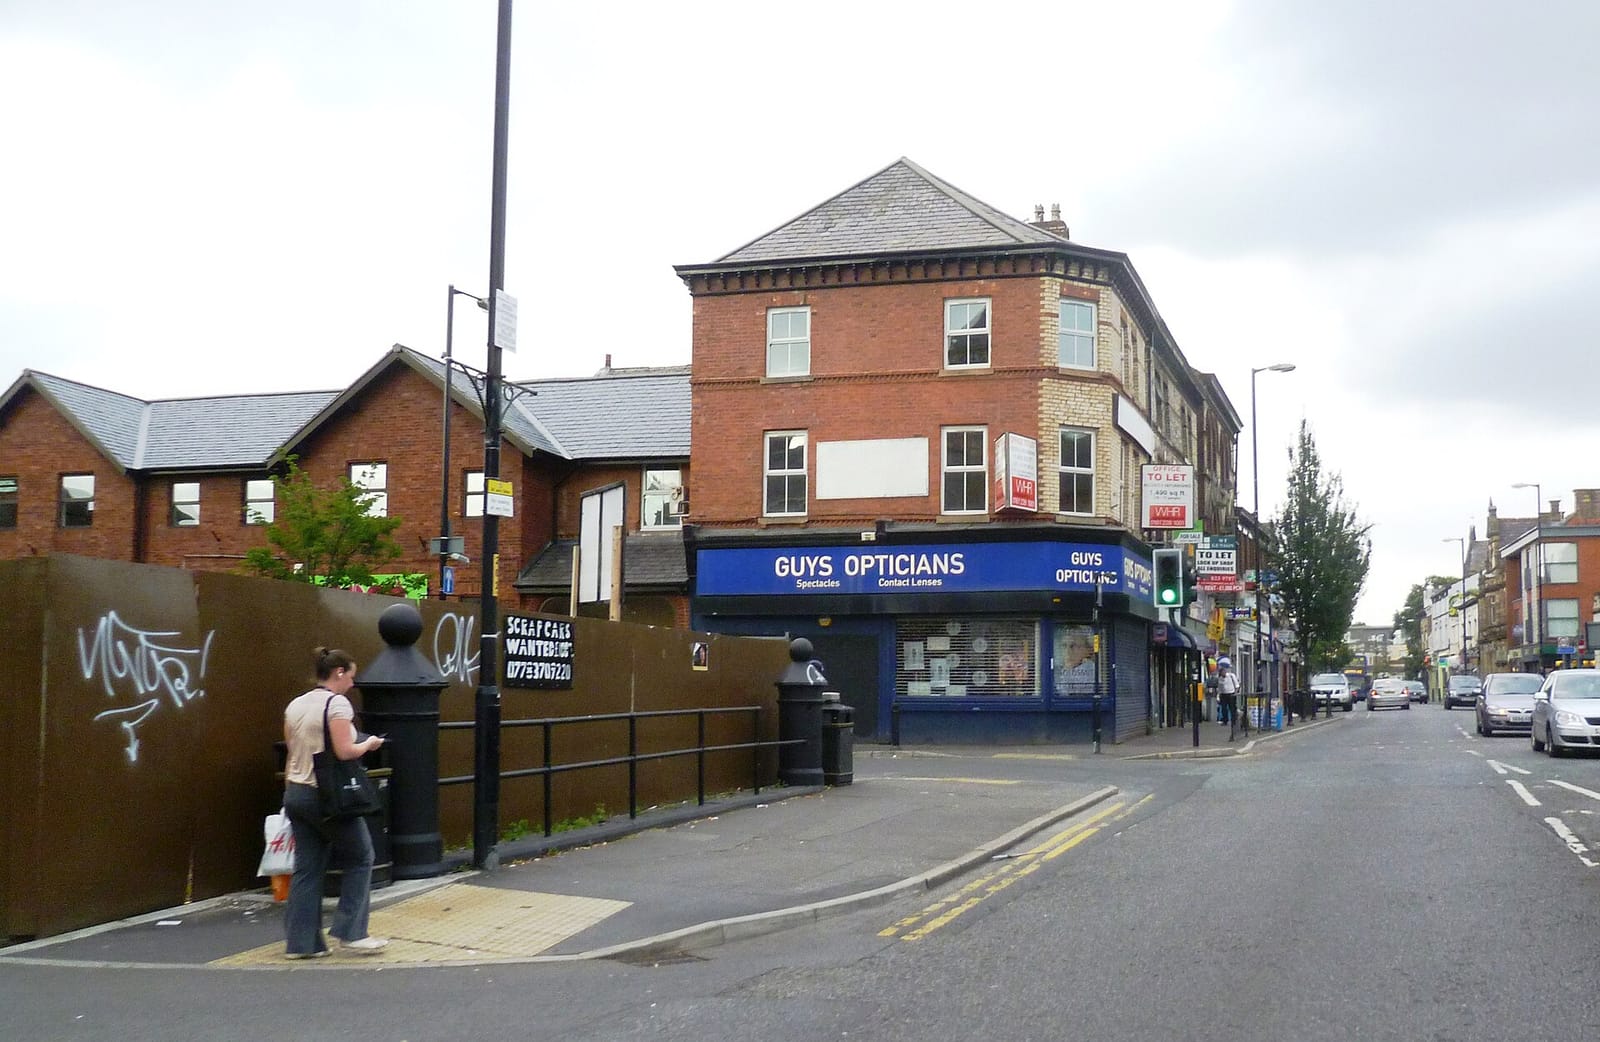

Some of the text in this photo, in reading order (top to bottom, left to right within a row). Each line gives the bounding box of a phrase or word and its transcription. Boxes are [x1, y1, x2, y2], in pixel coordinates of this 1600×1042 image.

[1147, 473, 1187, 482] TO LET
[1015, 478, 1033, 495] WHR
[1154, 506, 1181, 517] WHR
[1071, 552, 1103, 566] GUYS
[1199, 551, 1233, 559] TO LET
[774, 552, 965, 577] GUYS OPTICIANS
[796, 579, 840, 590] Spectacles
[878, 577, 943, 587] Contact Lenses
[507, 616, 571, 640] SCRAP CARS
[506, 638, 554, 657] WANTED
